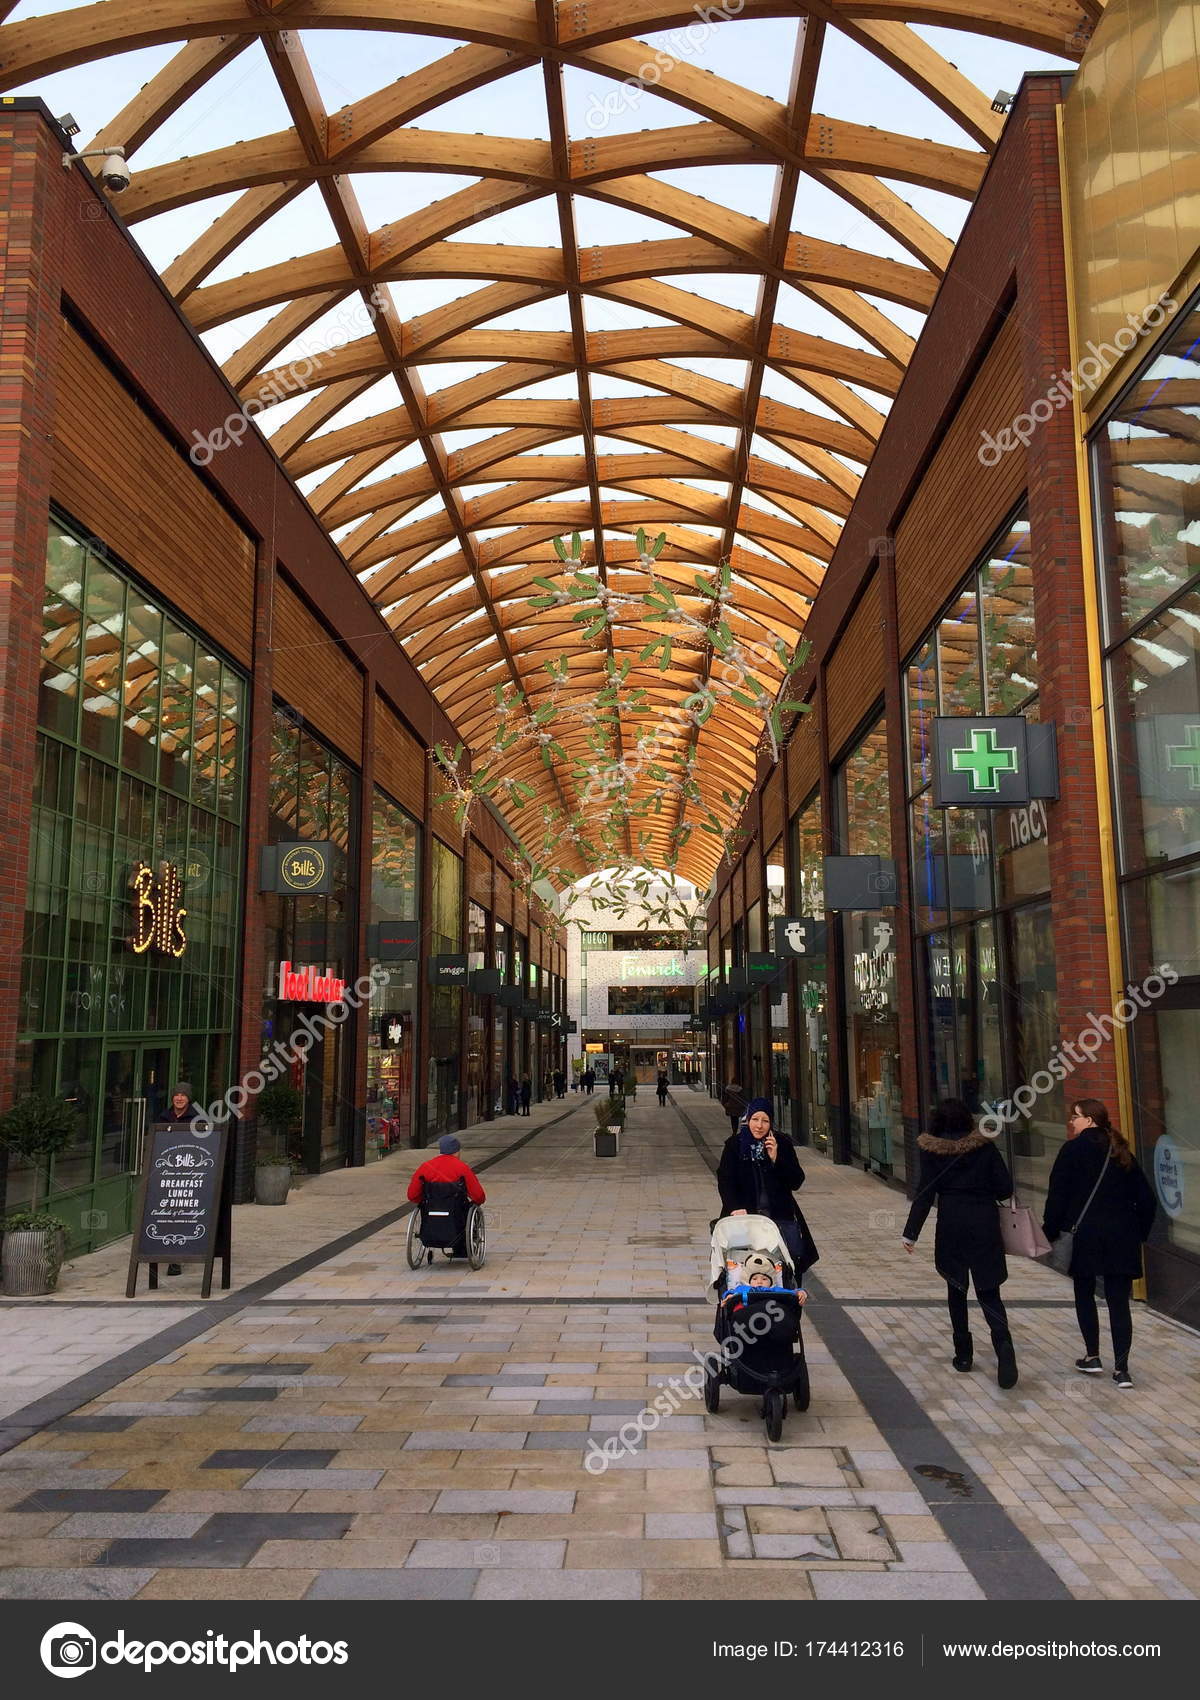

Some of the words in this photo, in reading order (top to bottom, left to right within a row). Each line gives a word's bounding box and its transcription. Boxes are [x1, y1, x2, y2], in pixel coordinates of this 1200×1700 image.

[291, 860, 315, 876] Bill's
[582, 932, 608, 945] FUEGO
[621, 957, 685, 980] Fenwick
[175, 1153, 196, 1168] Bill's
[160, 1179, 203, 1188] BREAKFAST
[168, 1189, 193, 1198] LUNCH
[170, 1199, 199, 1208] DINNER
